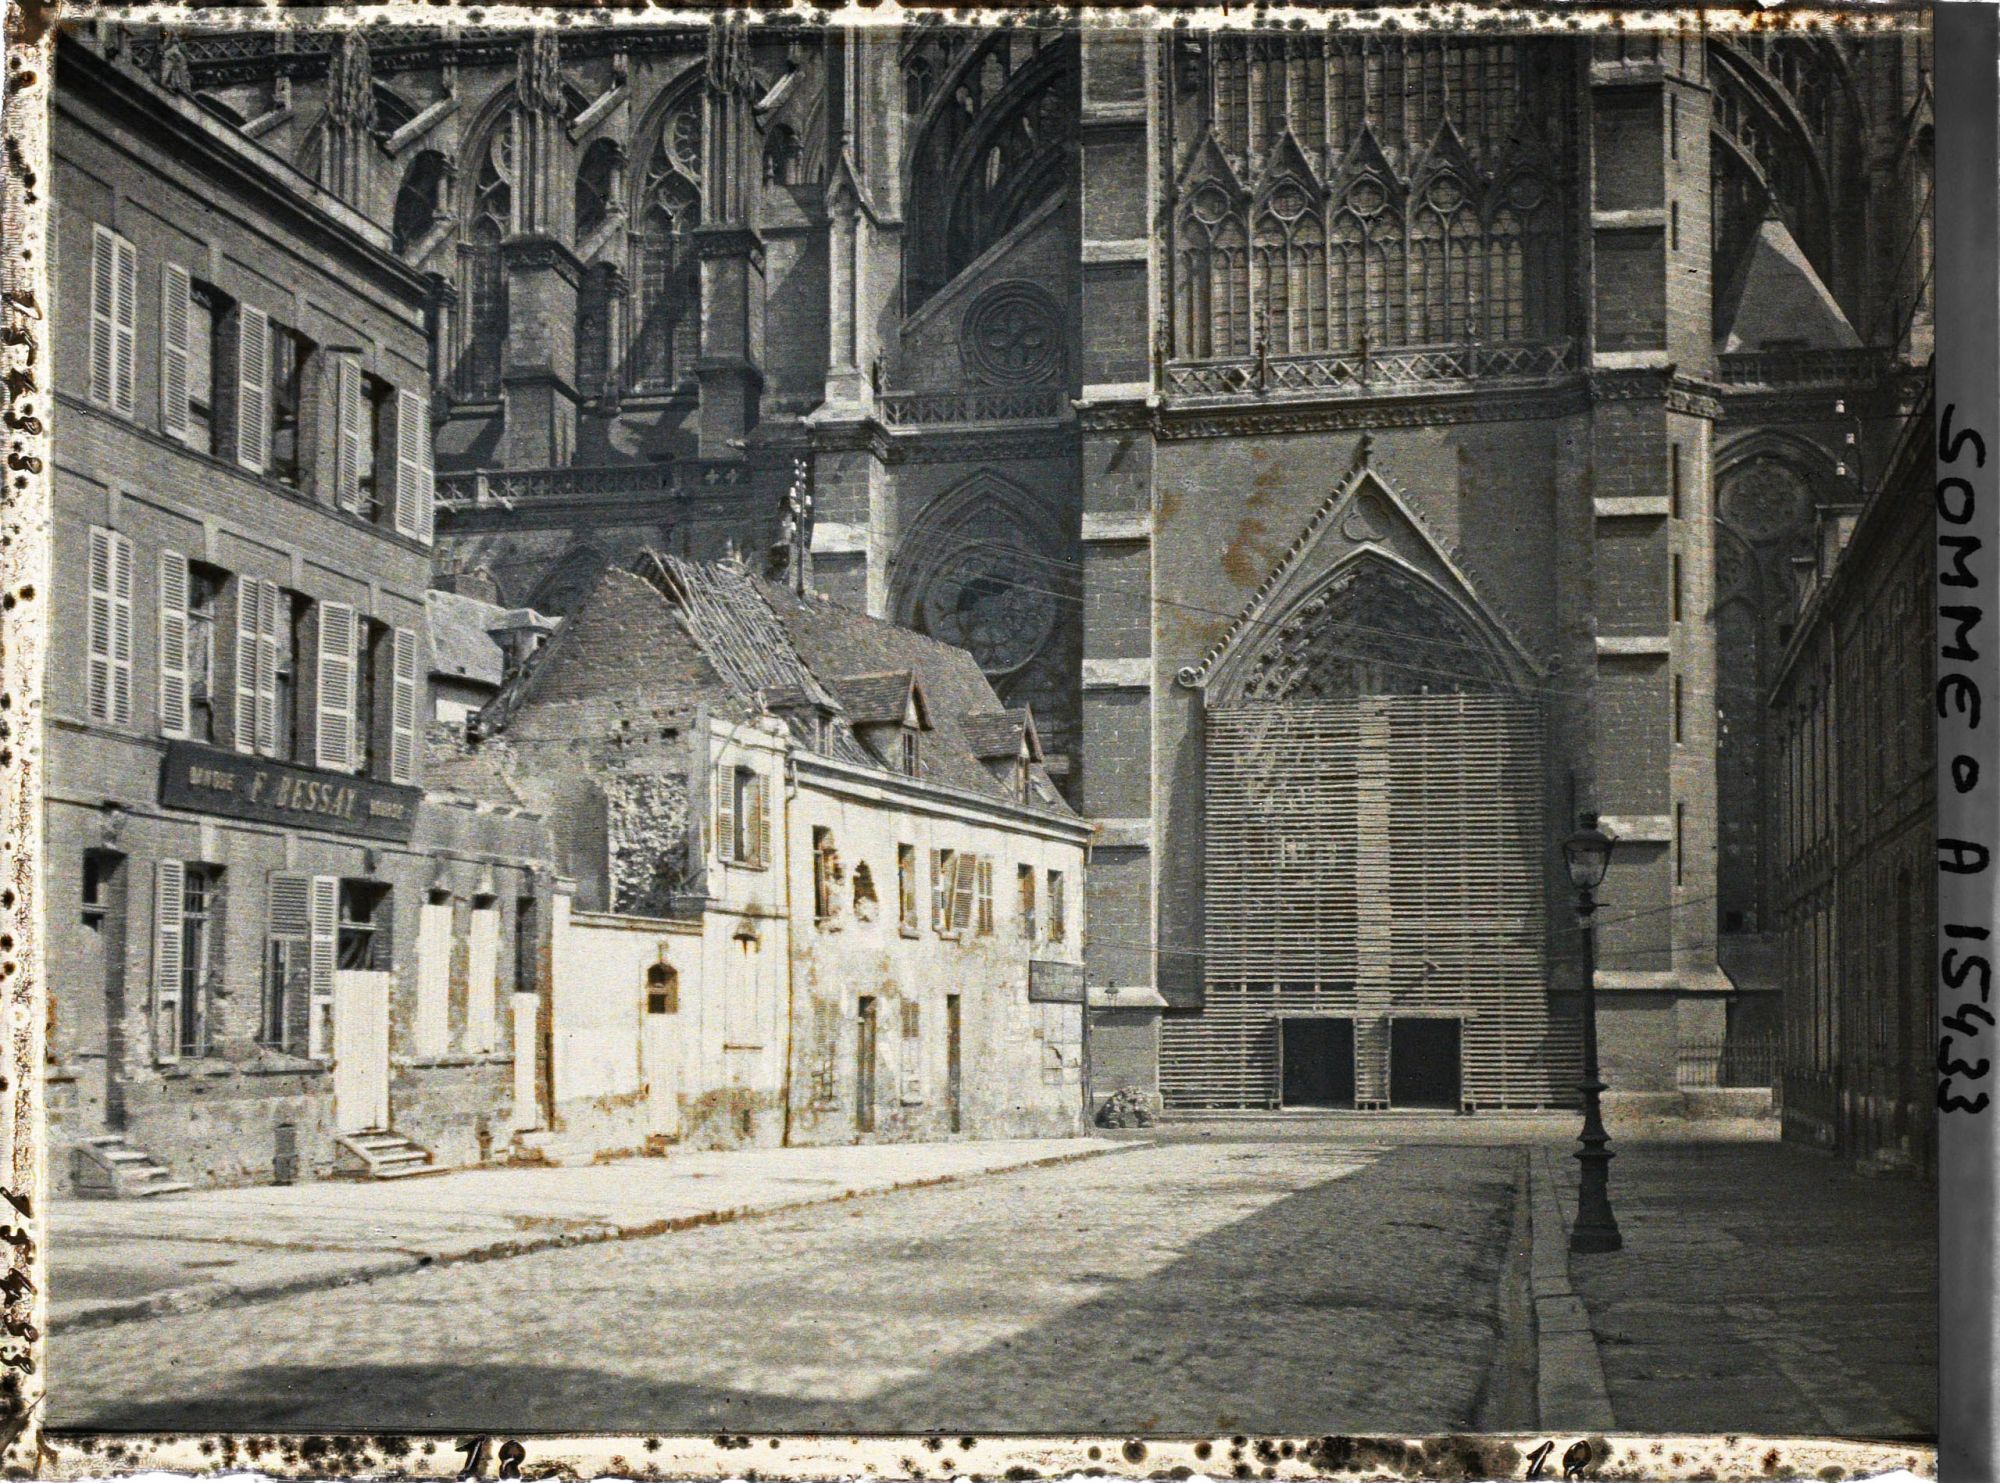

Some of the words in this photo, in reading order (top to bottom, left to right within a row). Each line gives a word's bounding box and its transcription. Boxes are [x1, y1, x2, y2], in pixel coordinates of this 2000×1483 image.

[1936, 404, 1986, 731] SOMME
[1936, 838, 1989, 875] A
[1936, 923, 1996, 1117] 15433
